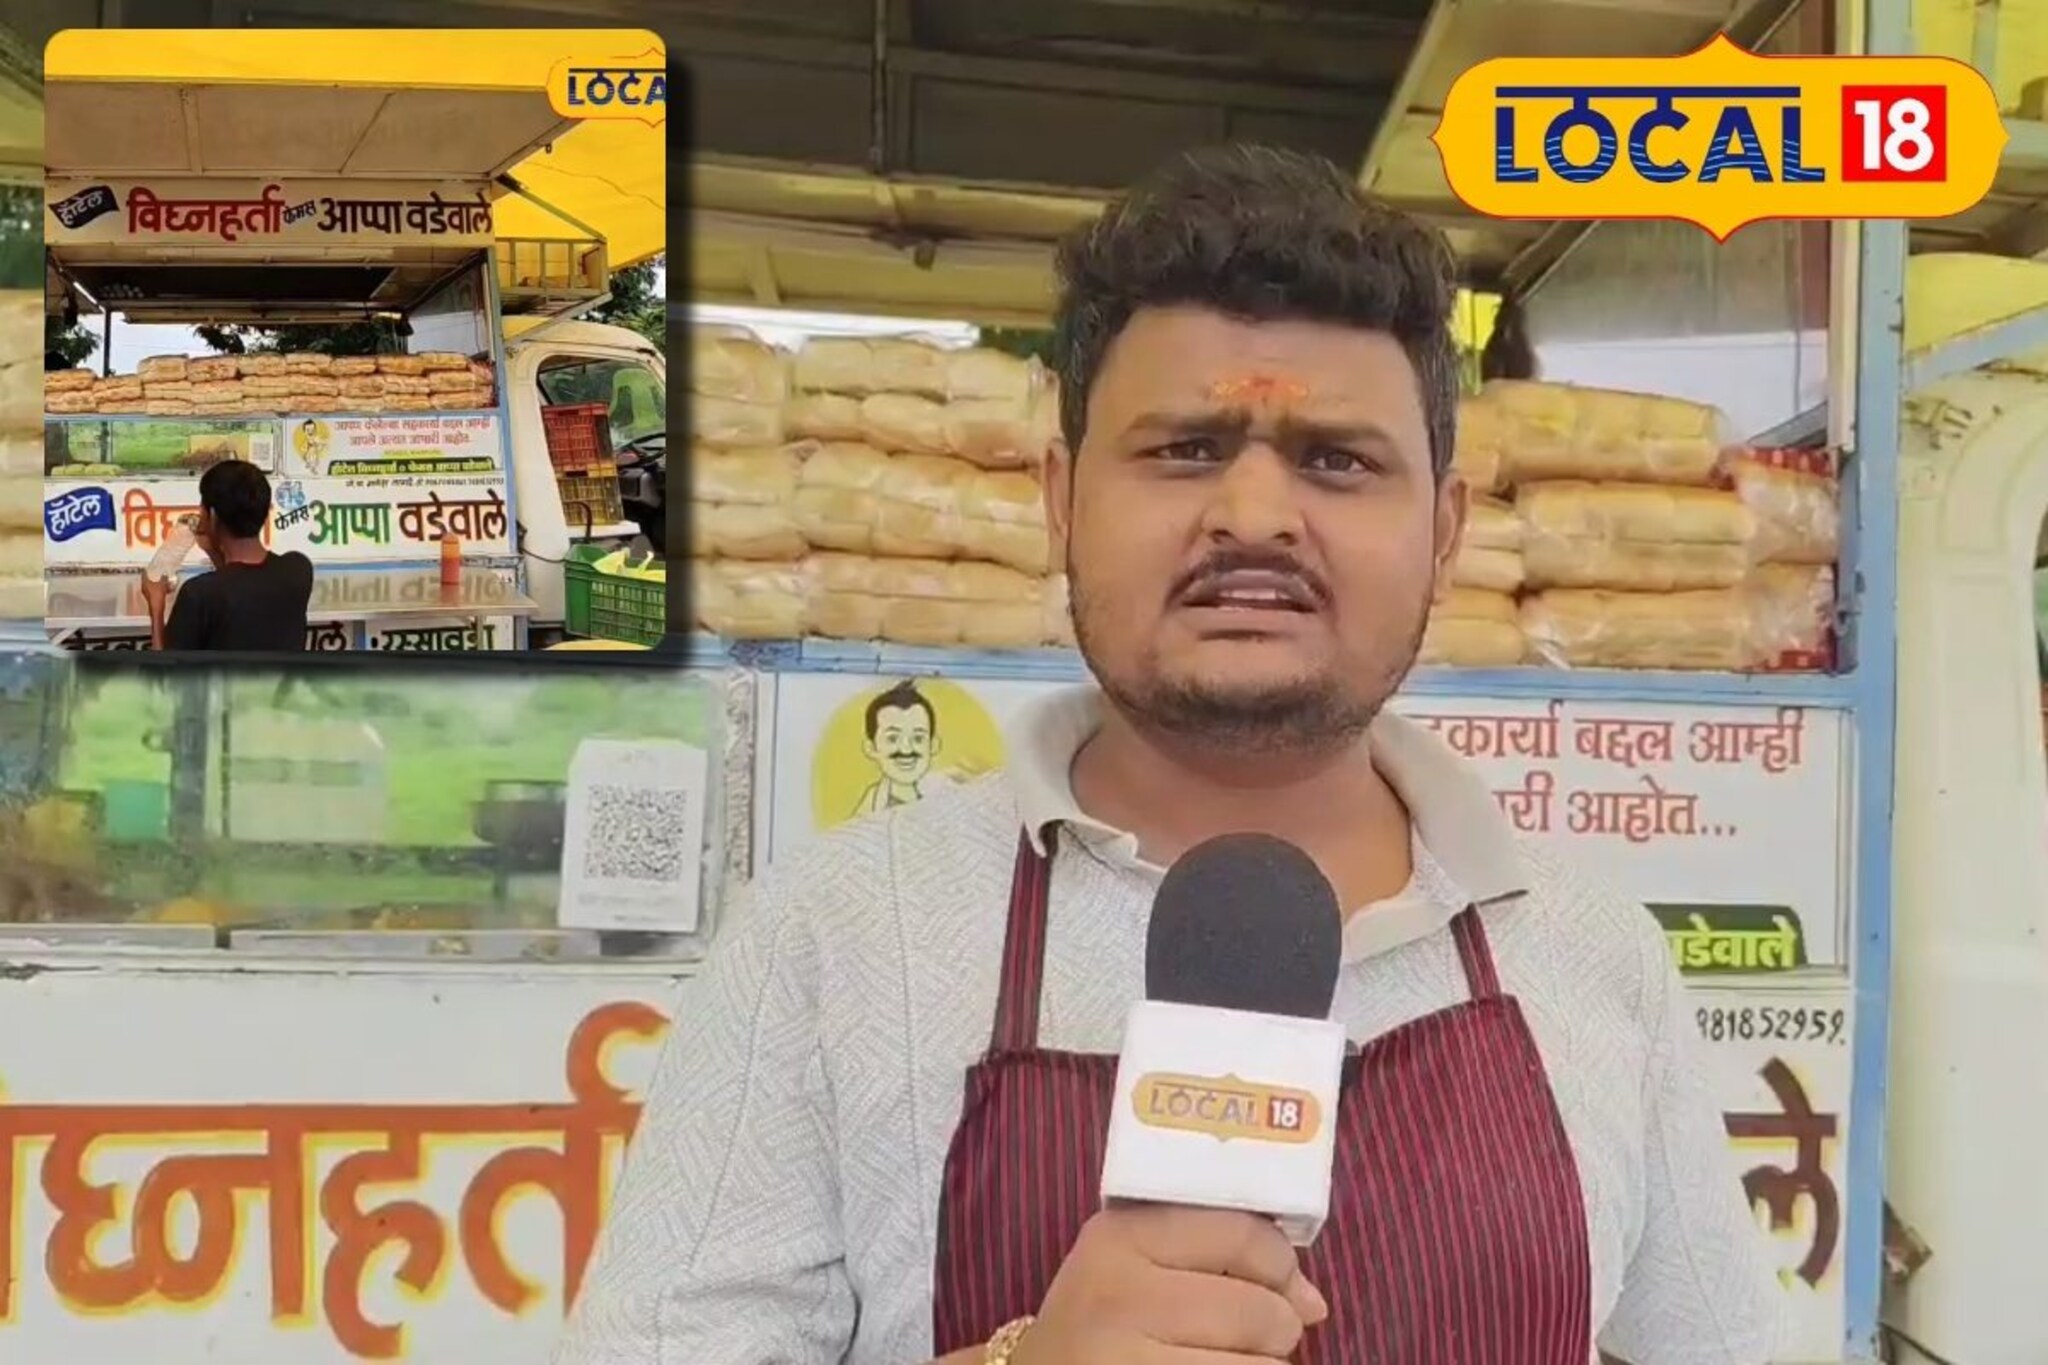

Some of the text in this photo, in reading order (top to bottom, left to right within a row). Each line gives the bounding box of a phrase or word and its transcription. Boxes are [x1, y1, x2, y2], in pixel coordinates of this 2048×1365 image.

[57, 190, 104, 226] हॉटेल
[126, 184, 286, 242] विघ्नहर्ता
[317, 197, 403, 234] आप्पा
[406, 190, 493, 235] वडेवाले
[48, 494, 101, 535] हॉटेल
[274, 504, 310, 531] फेमस
[308, 499, 391, 545] आप्पा
[398, 490, 507, 544] वडेवाले
[1402, 698, 1804, 774] कार्या बद्दल आम्ही
[1150, 1080, 1299, 1128] LOCAL 18
